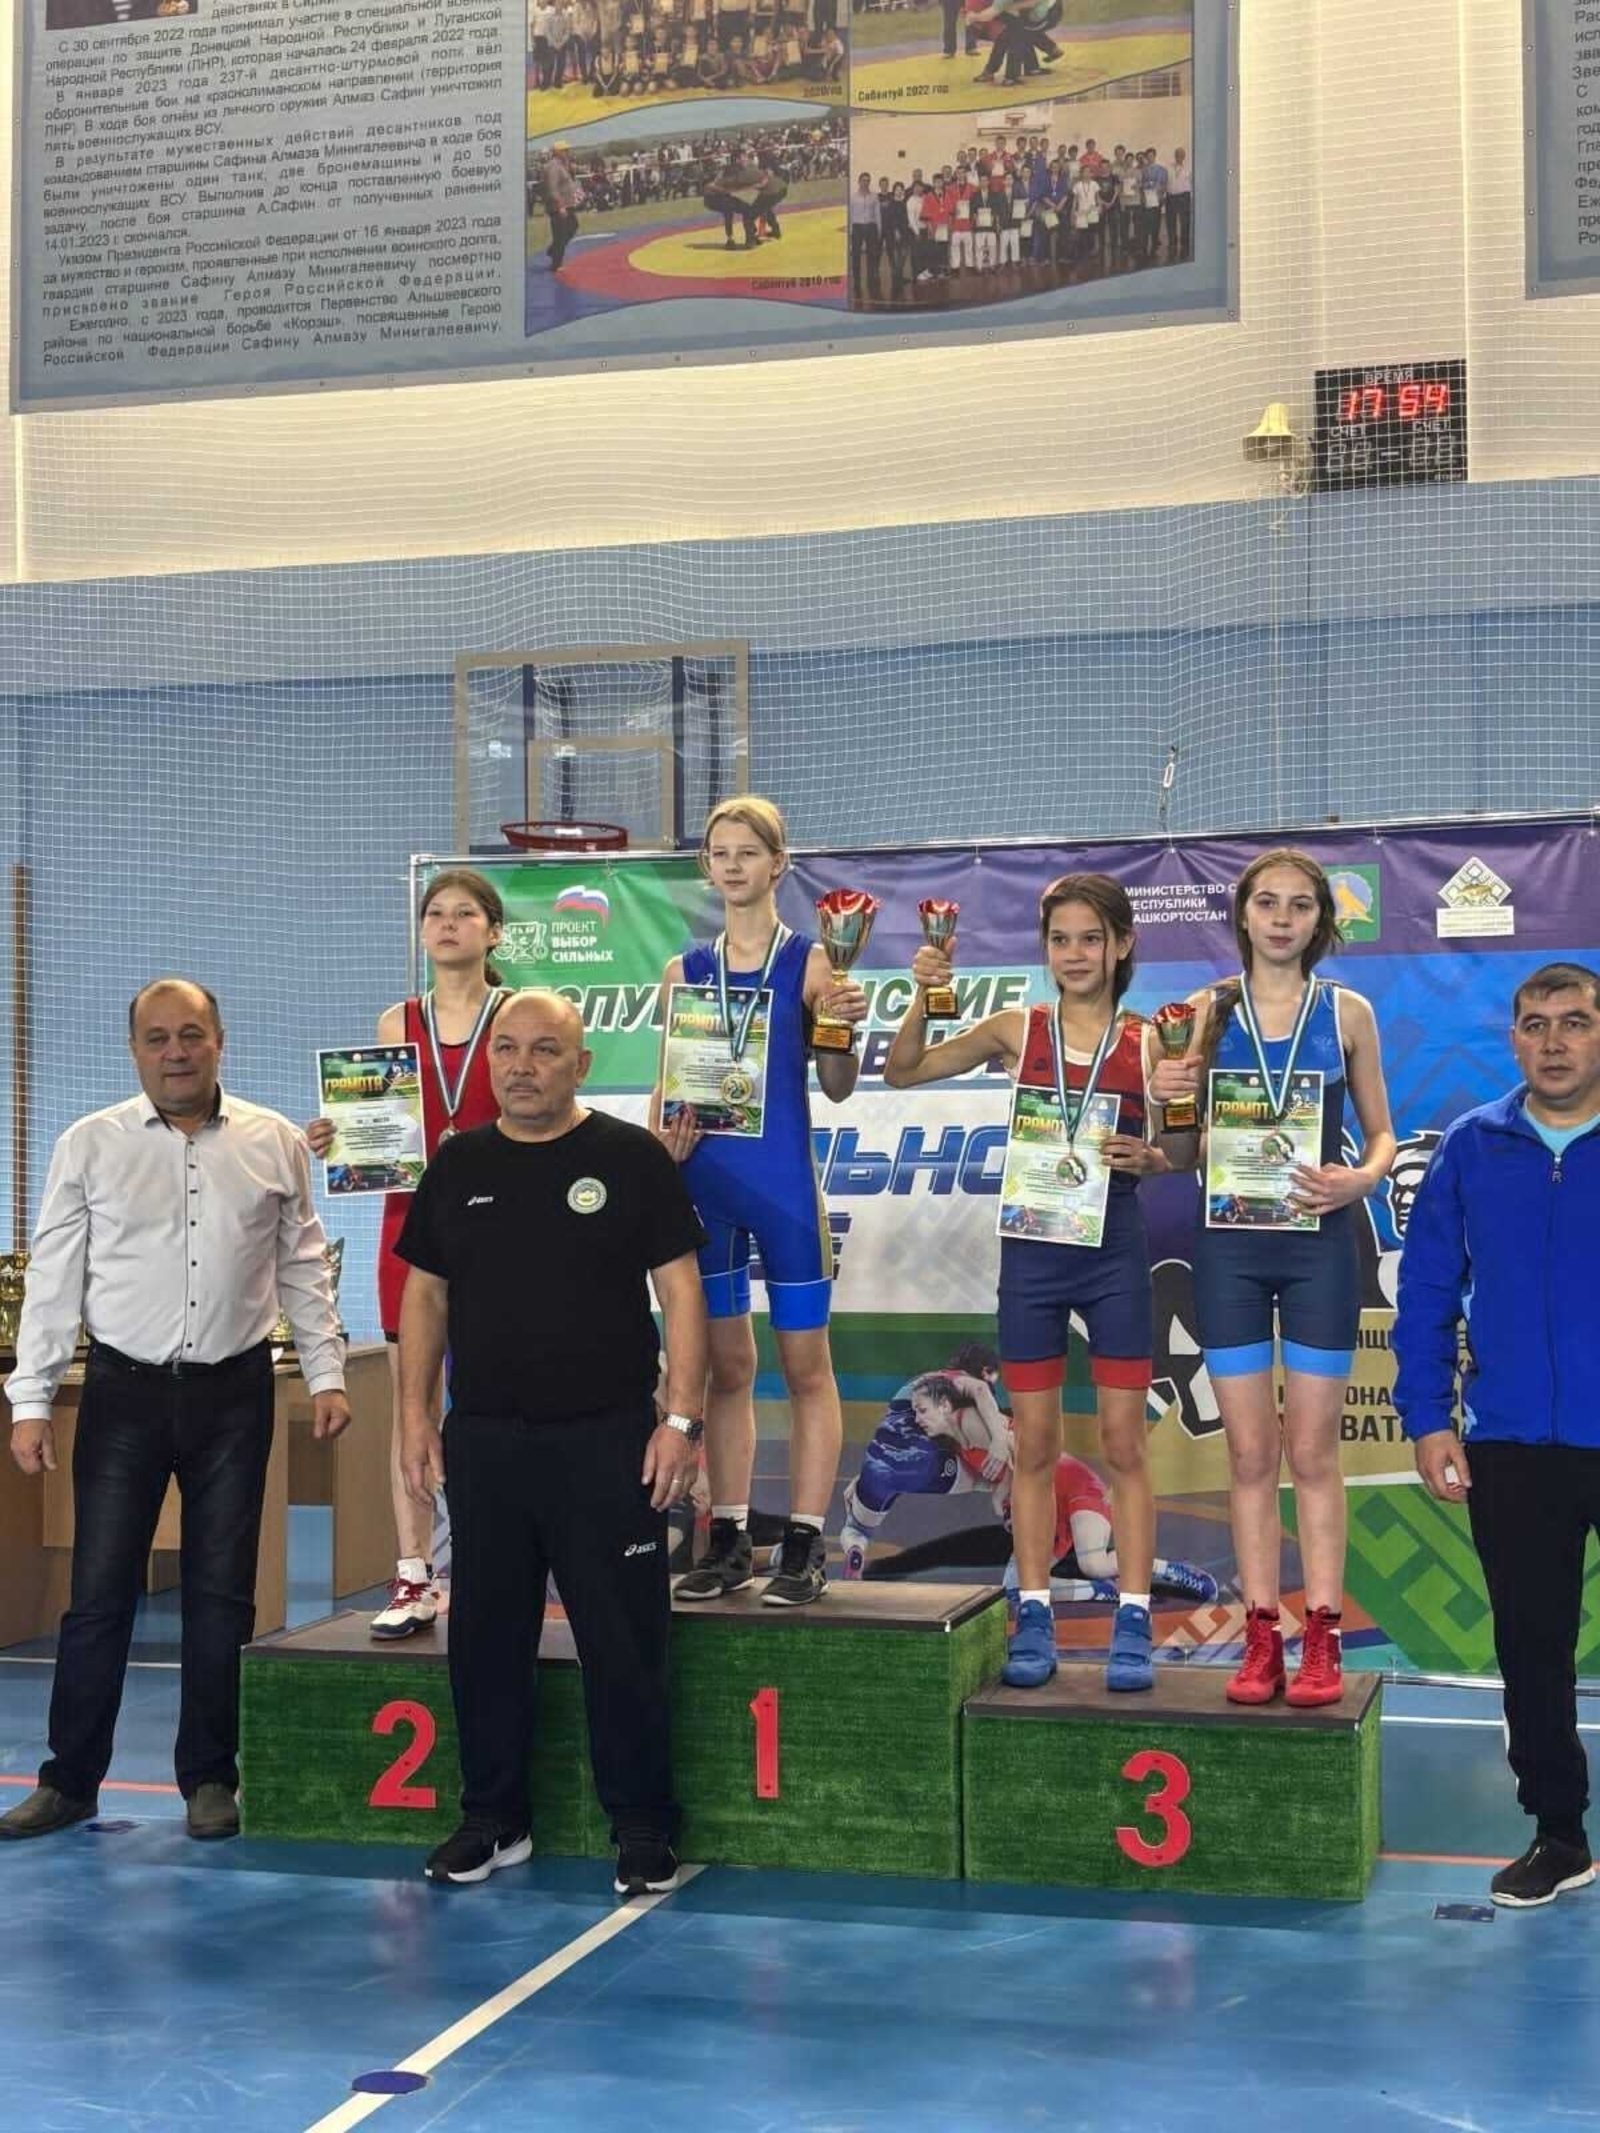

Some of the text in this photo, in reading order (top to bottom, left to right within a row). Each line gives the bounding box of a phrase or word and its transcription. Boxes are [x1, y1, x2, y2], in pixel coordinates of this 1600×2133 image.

[45, 7, 502, 72] операции по защите Донецкой Народной Республики Луганской
[73, 38, 88, 50] 30
[92, 31, 149, 50] сентября
[153, 27, 183, 41] 2022
[188, 26, 216, 39] года
[220, 18, 284, 35] принимал
[288, 12, 340, 27] участие
[355, 0, 441, 20] специальной
[45, 69, 107, 88] Народной
[109, 61, 185, 81] Республики
[230, 52, 282, 67] которая
[285, 45, 347, 59] началась
[349, 40, 366, 52] 24
[370, 33, 428, 52] февраля
[431, 29, 465, 43] 2022
[56, 91, 64, 102] В
[75, 87, 123, 102] январе
[135, 79, 166, 93] 2023
[178, 77, 208, 90] года
[431, 48, 463, 60] полк
[44, 98, 148, 121] оборонительные
[155, 95, 178, 107] бои
[184, 95, 200, 104] на
[206, 81, 321, 103] краснолиманском
[328, 71, 413, 90] направлении
[99, 78, 501, 132] ходе боя личного оружия Алмаз Сафин уничтожил
[43, 167, 141, 187] командованием
[146, 160, 209, 176] старшины
[213, 152, 266, 169] Сафина
[271, 146, 319, 161] Алмаза
[442, 133, 472, 146] ходе
[476, 127, 501, 140] боя
[55, 113, 501, 167] В результате мужественных действий десантников под
[76, 129, 192, 150] военнослужащих
[42, 187, 80, 201] были
[90, 180, 174, 198] уничтожены
[184, 176, 219, 189] один
[277, 167, 305, 180] две
[316, 153, 422, 176] бронемашины
[452, 151, 472, 163] до
[483, 145, 502, 158] 50
[42, 162, 502, 220] военнослужащих Выполнив конца поставленную боевую
[99, 217, 136, 228] после
[146, 211, 170, 224] боя
[180, 207, 246, 222] старшина
[326, 197, 341, 206] от
[352, 188, 433, 206] полученных
[443, 179, 502, 197] ранений
[184, 236, 261, 253] Российской
[264, 229, 339, 248] Федерации
[342, 230, 357, 239] от
[363, 226, 379, 237] 16
[382, 223, 431, 238] января
[434, 218, 467, 231] 2023
[470, 217, 501, 230] года
[43, 287, 93, 301] гвардии
[180, 272, 234, 289] Сафину
[247, 267, 295, 283] Алмазу
[428, 251, 501, 268] посмертно
[60, 268, 120, 283] мужество
[191, 254, 278, 271] проявленные
[281, 252, 306, 263] при
[308, 244, 387, 259] исполнении
[158, 310, 187, 322] 2023
[237, 302, 310, 318] проводится
[320, 292, 397, 311] Первенство
[408, 284, 501, 302] Альшеевского
[223, 286, 271, 302] Героя
[283, 277, 384, 295] Российской
[43, 349, 123, 365] Российской
[147, 340, 229, 359] Федерации
[241, 335, 299, 352] Сафину
[313, 329, 366, 346] Алмазу
[122, 324, 215, 344] национальной
[225, 320, 271, 336] борьбе
[356, 308, 449, 325] посвященные
[460, 301, 501, 317] Герою
[1364, 370, 1414, 385] ВРЕМЯ
[1125, 883, 1225, 897] МИНИСТЕРСТВО
[1129, 897, 1207, 911] ЕСПУБЛИКИ
[552, 920, 598, 934] ПРОЕКТ
[1131, 910, 1228, 924] АШКОРТОСТАН
[551, 949, 614, 963] СИЛЬНЫХ
[552, 936, 598, 949] ВЫБОР
[370, 1701, 437, 1808] 2
[751, 1689, 778, 1796] 1
[1117, 1751, 1191, 1867] 3
